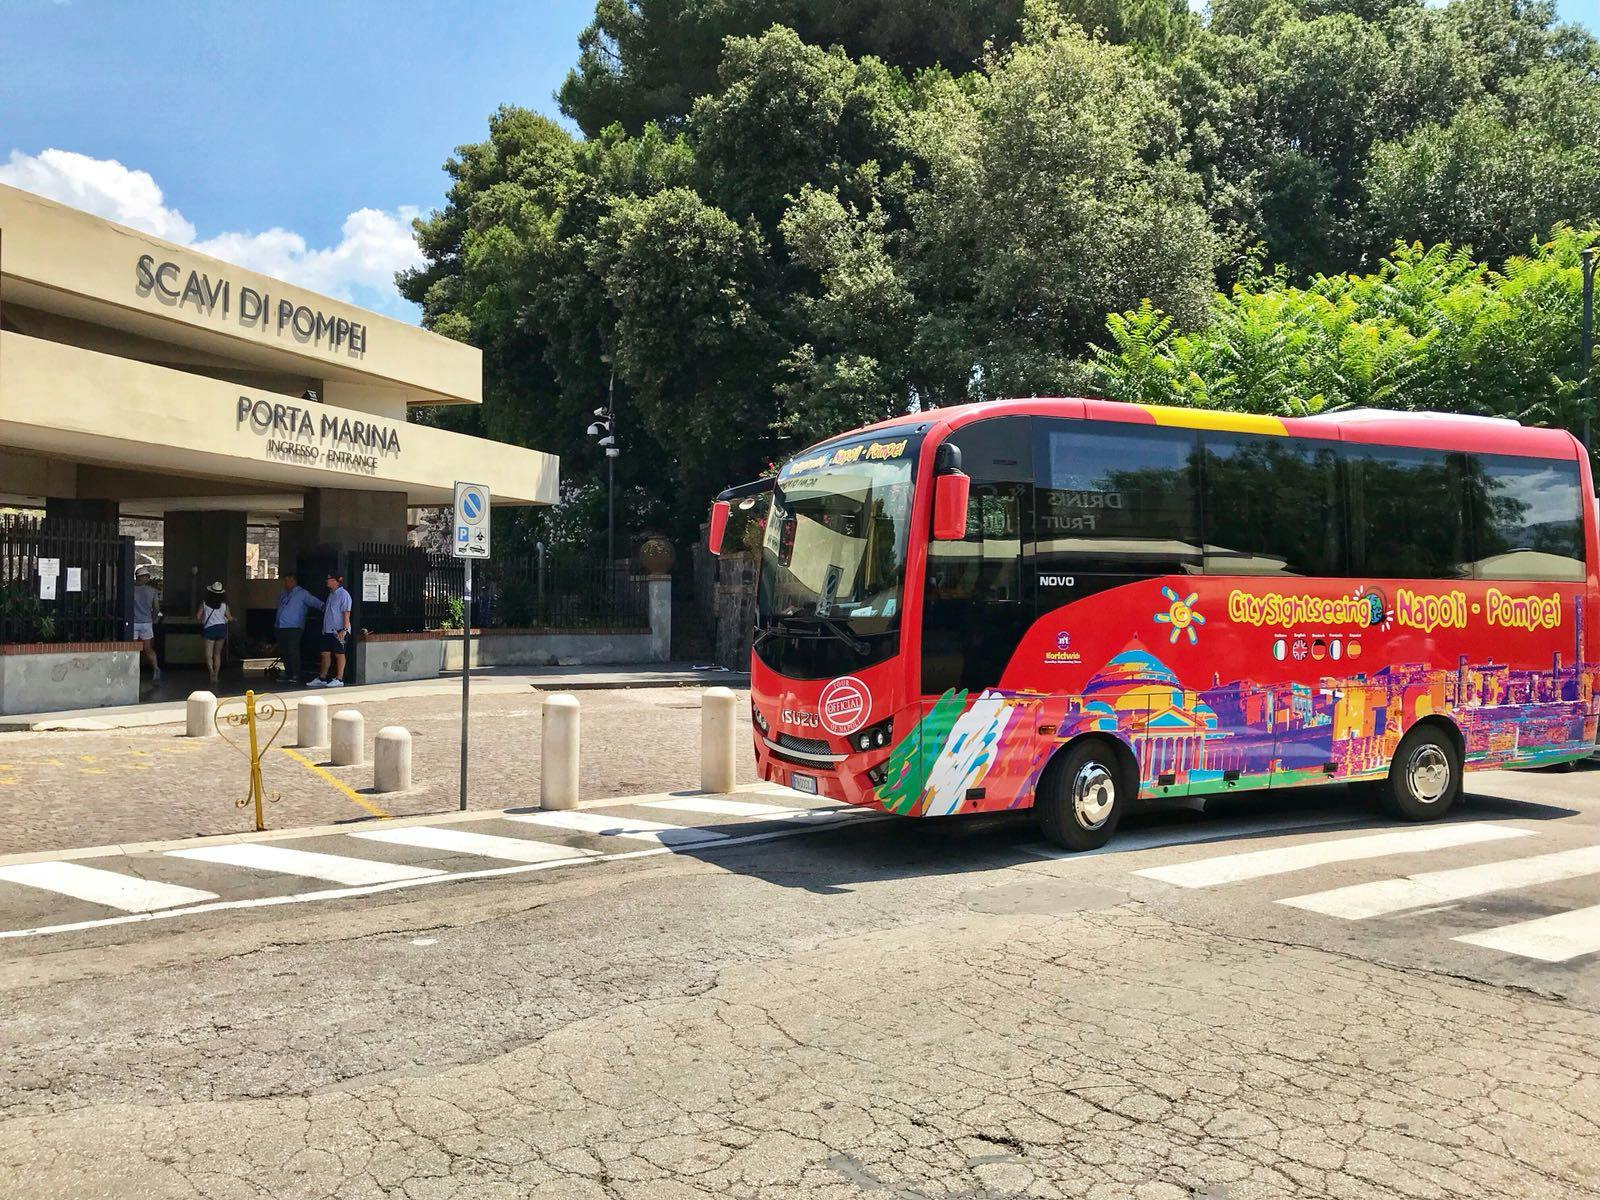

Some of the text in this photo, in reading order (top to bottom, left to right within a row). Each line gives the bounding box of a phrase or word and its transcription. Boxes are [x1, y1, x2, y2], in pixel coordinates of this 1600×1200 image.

[138, 254, 366, 353] SCAVI DI POMPEI
[238, 395, 401, 452] PORTA MARINA
[268, 439, 319, 459] INGRESSO
[327, 450, 378, 469] ENTRANCE
[865, 439, 908, 460] Pompei
[1039, 576, 1075, 587] NOVO
[1397, 588, 1467, 633] Napoli
[1486, 588, 1561, 632] Pompei
[827, 698, 860, 713] OFFICIAL
[781, 709, 819, 728] ISUZU
